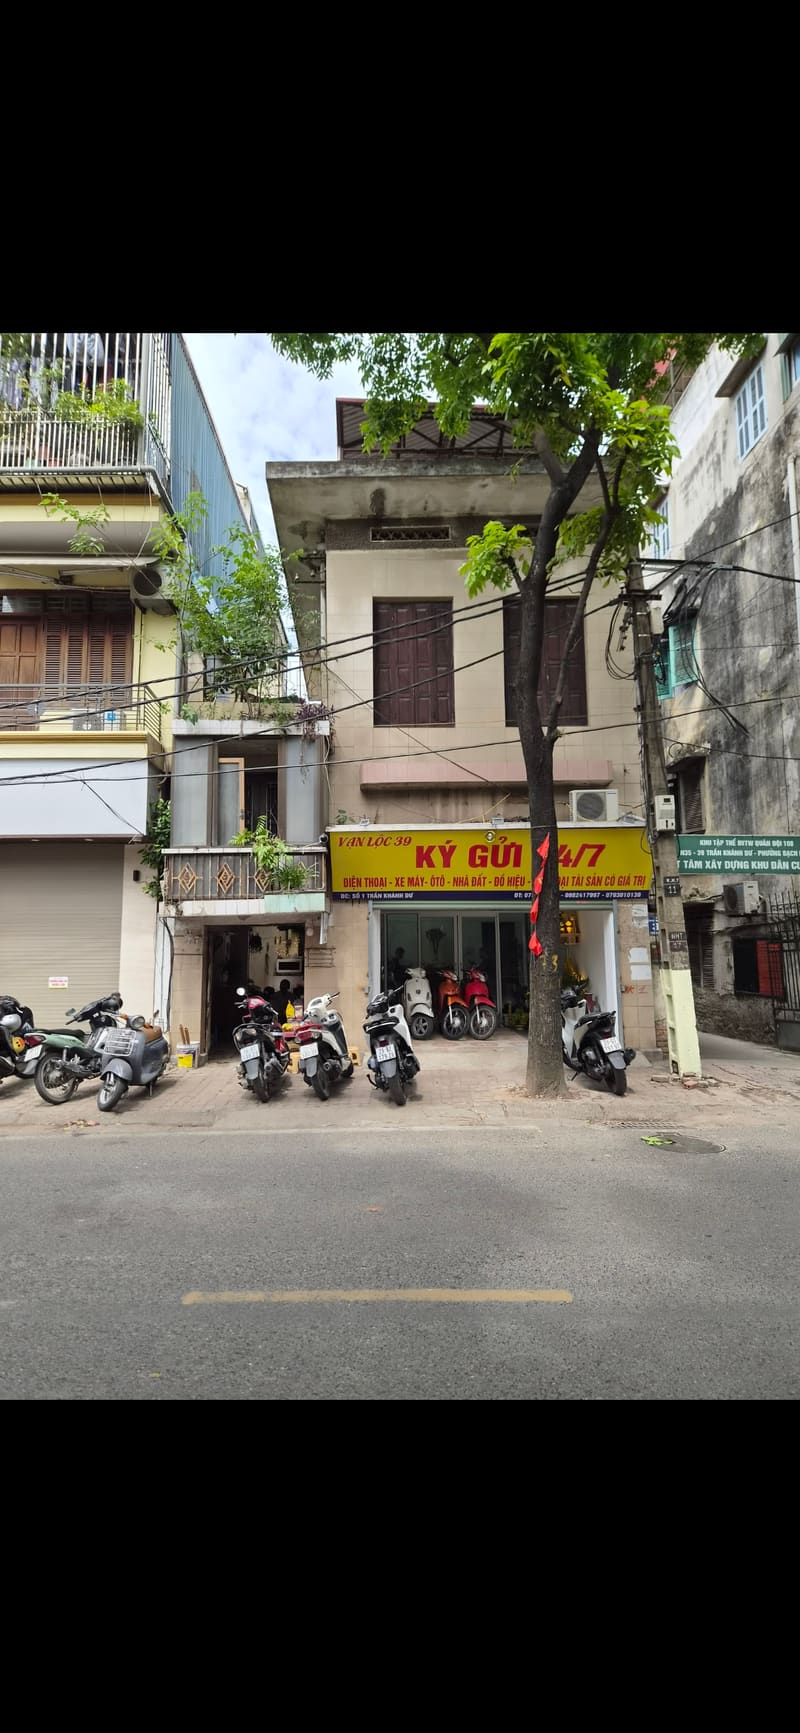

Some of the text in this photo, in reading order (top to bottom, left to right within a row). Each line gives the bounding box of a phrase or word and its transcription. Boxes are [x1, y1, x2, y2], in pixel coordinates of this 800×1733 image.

[338, 834, 412, 850] VẠN LỘC 39
[416, 836, 606, 868] KÝ GỬI 4/7
[683, 859, 703, 870] TÂM
[705, 859, 722, 870] XÂY
[724, 860, 750, 871] DỰNG
[751, 860, 769, 870] KHU
[771, 859, 789, 870] DÂN
[344, 875, 362, 890] ĐIỆN
[365, 877, 386, 890] THOẠI
[395, 876, 405, 888] XE
[452, 874, 468, 887] NHÀ
[472, 872, 487, 887] ĐẤT
[507, 876, 526, 889] HIỆU
[572, 874, 584, 886] TÀI
[586, 872, 602, 886] SẢN
[618, 873, 631, 886] GIÁ
[634, 875, 646, 888] TRỊ
